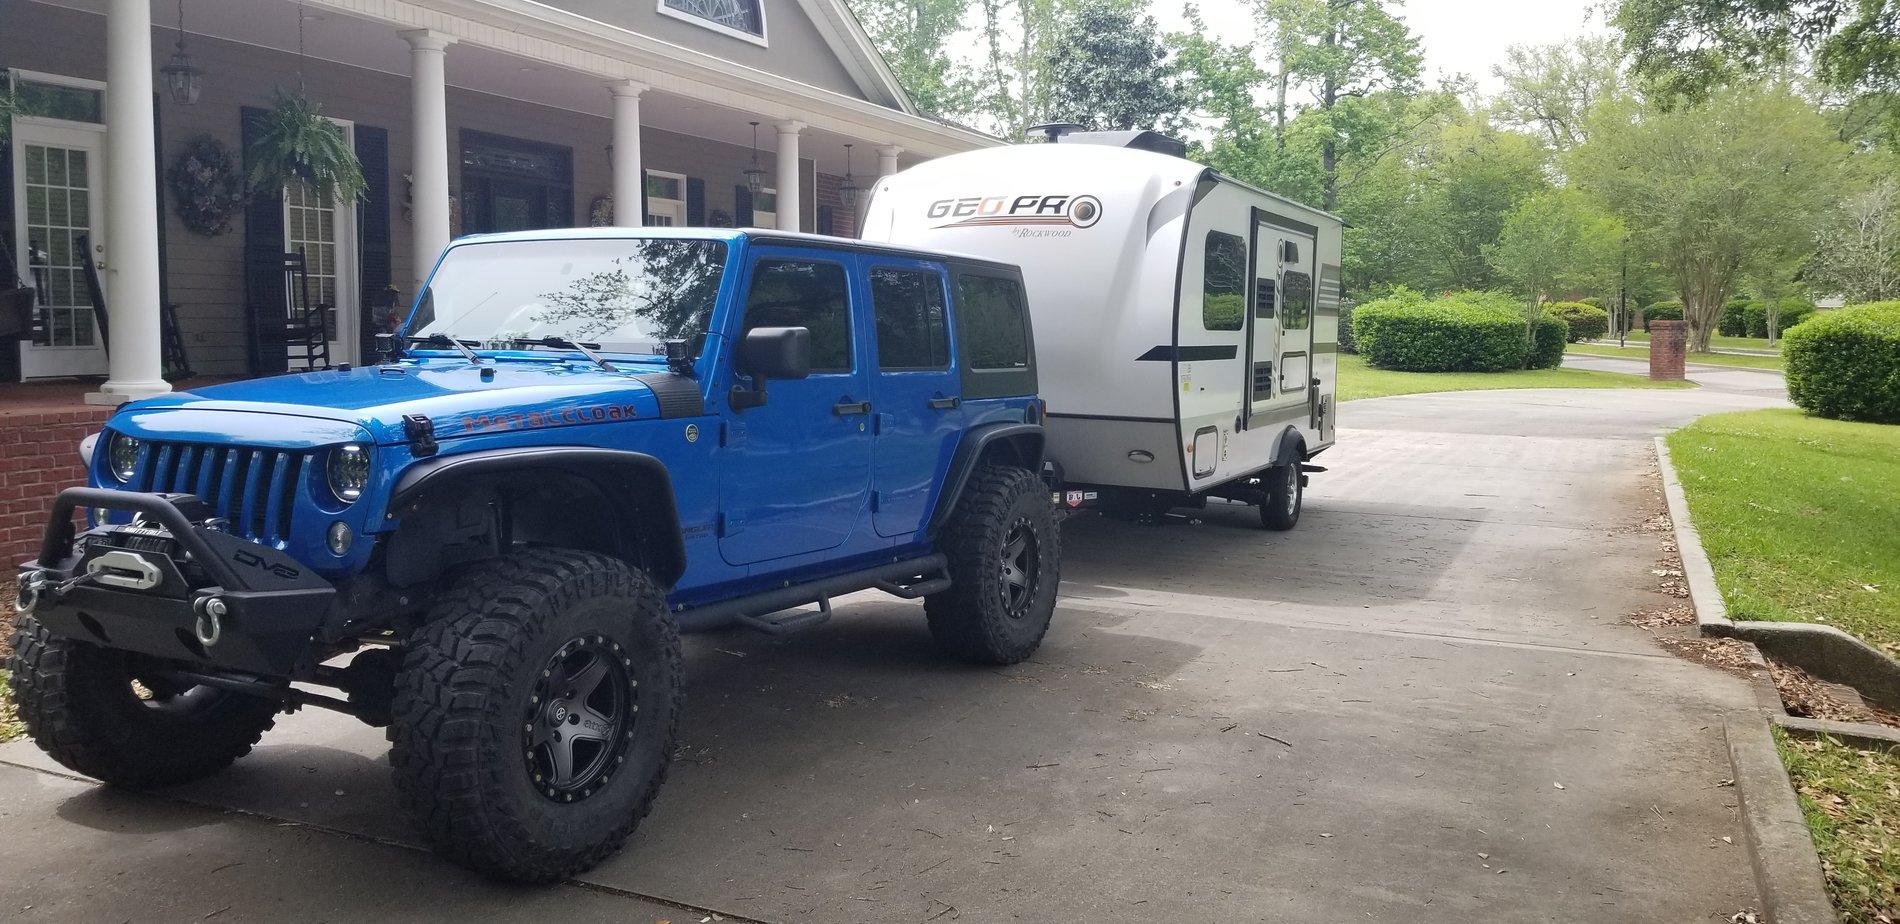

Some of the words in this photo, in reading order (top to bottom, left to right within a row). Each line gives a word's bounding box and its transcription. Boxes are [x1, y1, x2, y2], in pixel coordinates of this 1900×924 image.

[927, 196, 1008, 218] GEO
[1008, 195, 1103, 229] PRO
[232, 549, 299, 579] DV8
